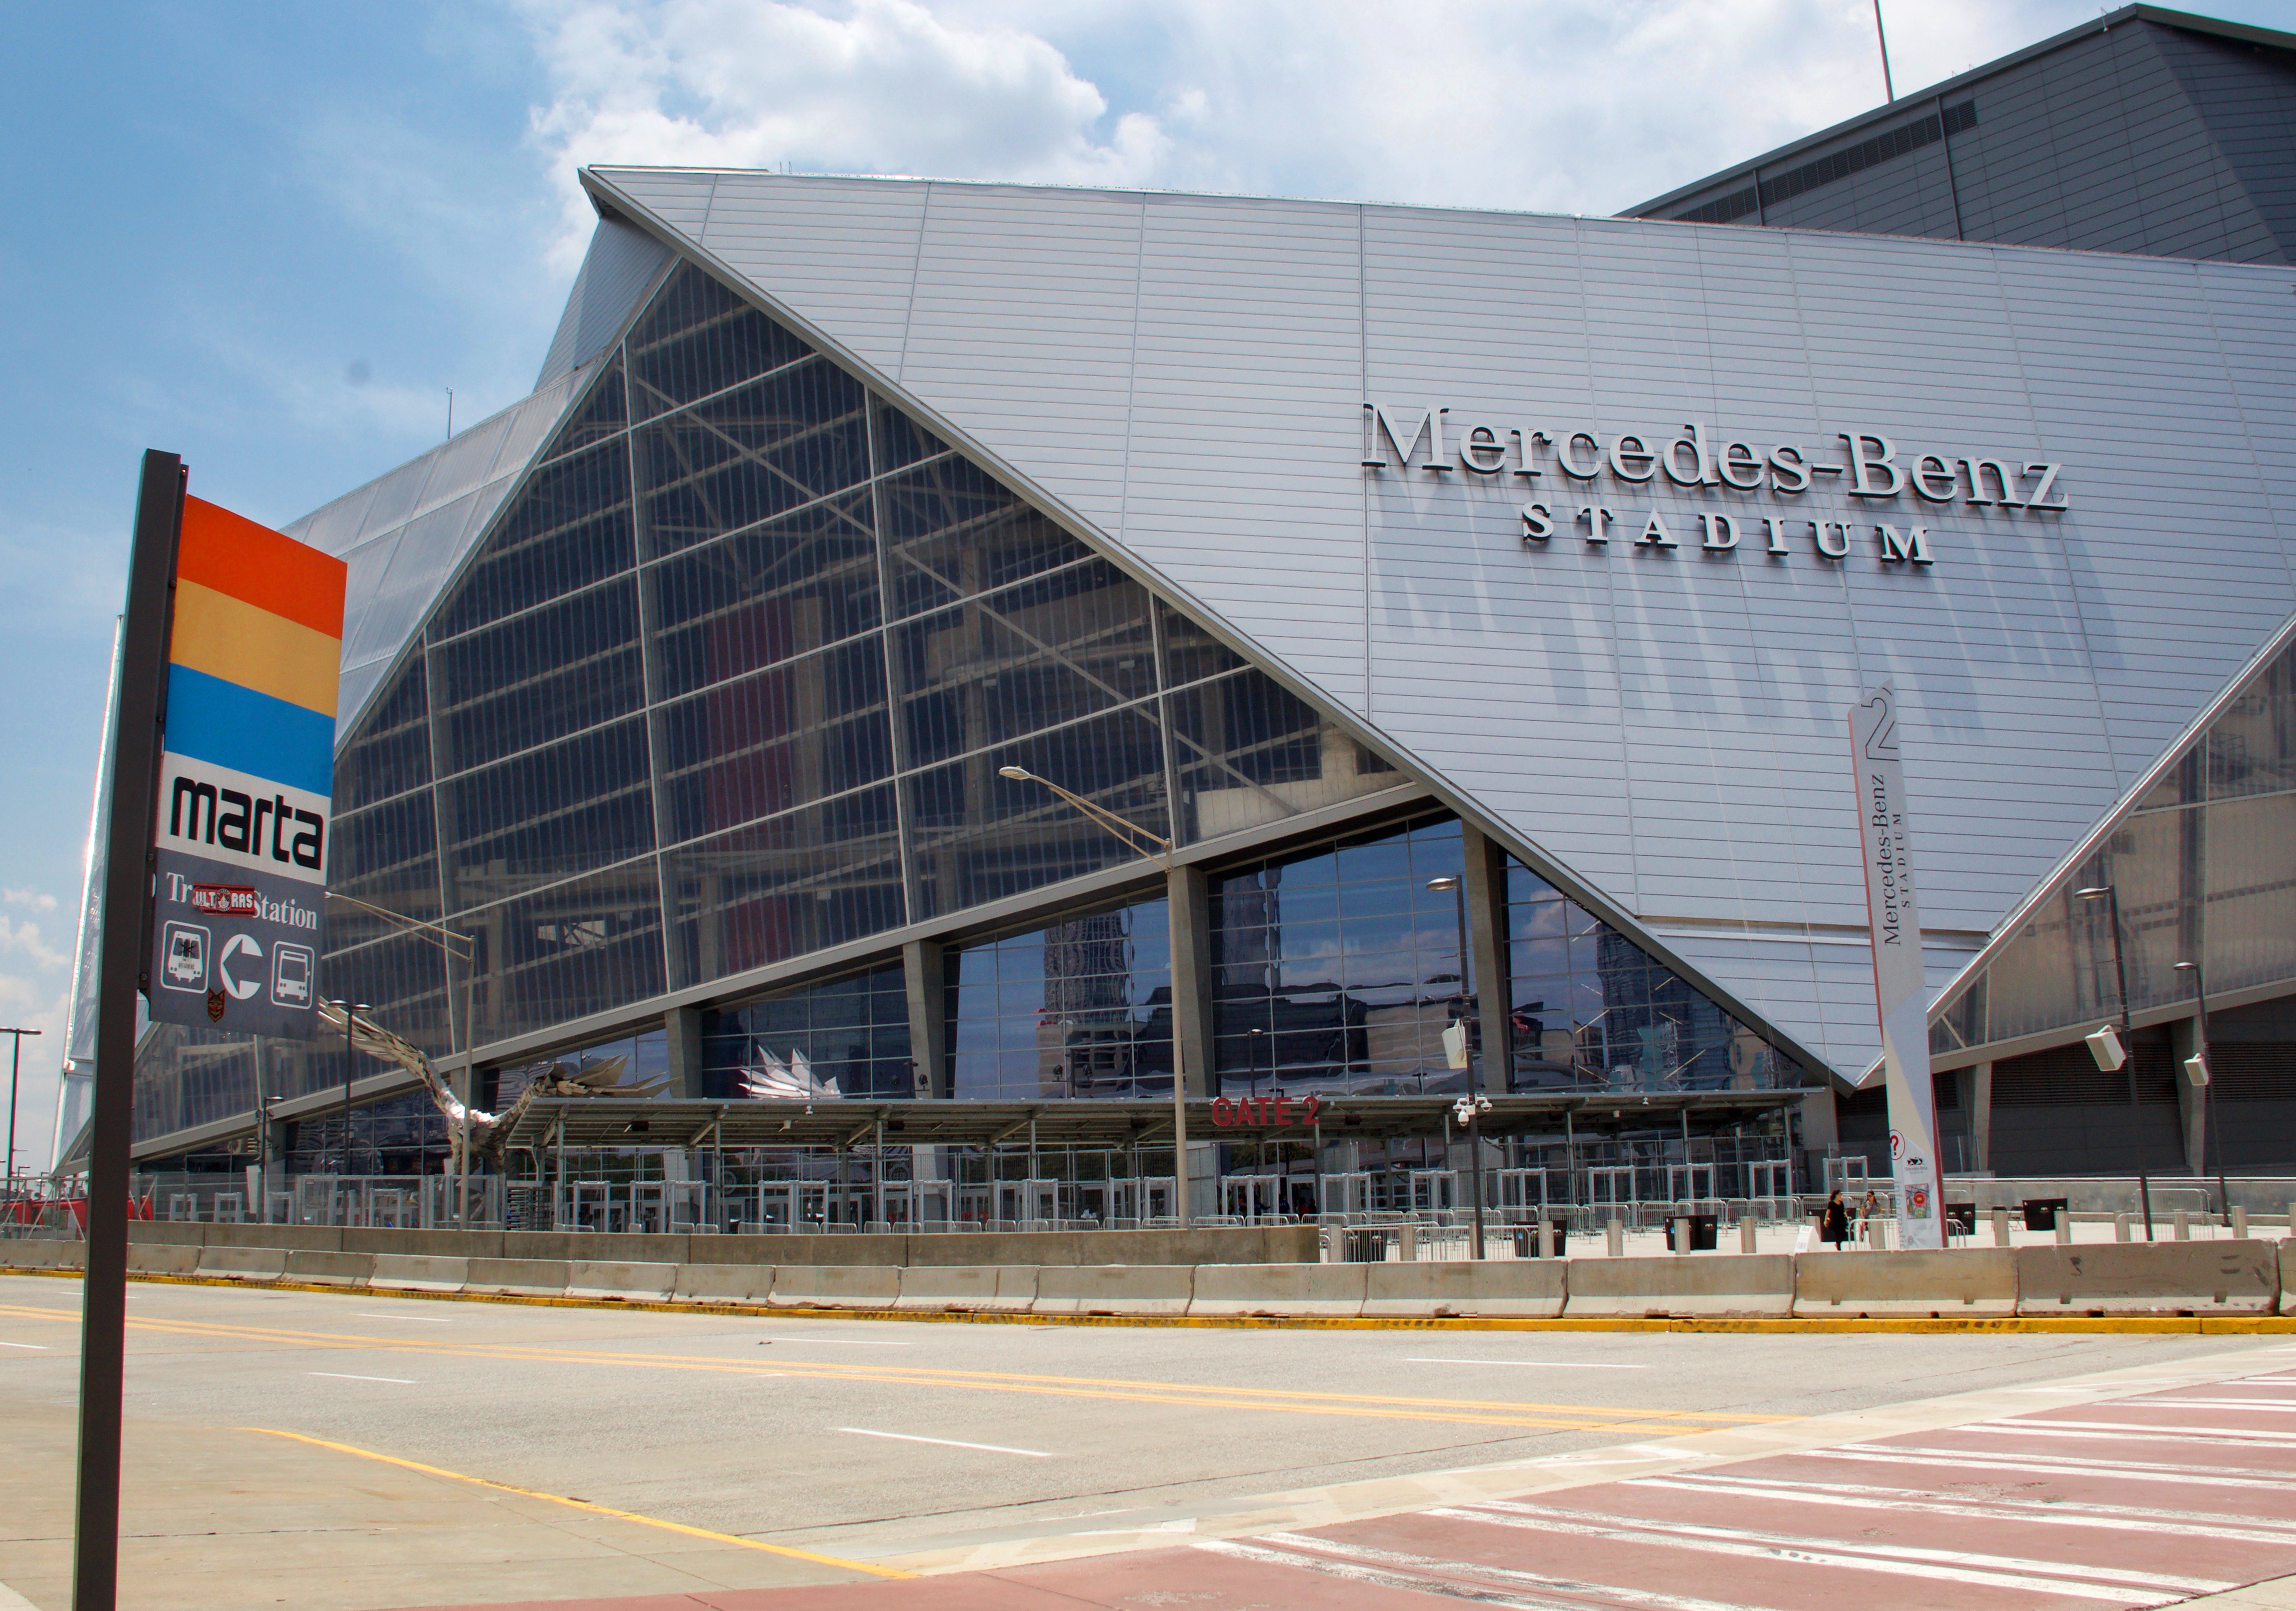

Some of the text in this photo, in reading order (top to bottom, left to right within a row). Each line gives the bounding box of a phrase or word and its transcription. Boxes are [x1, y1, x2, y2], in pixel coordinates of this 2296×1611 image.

[1362, 401, 2068, 512] Mercedes-Benz
[1522, 501, 1934, 565] STADIUM
[1861, 687, 1900, 761] 2
[170, 776, 324, 871] marta
[1872, 774, 1901, 946] Mercedes-Benz
[1891, 812, 1910, 908] STADIUM
[252, 890, 317, 930] Station
[1212, 1095, 1319, 1126] GATE 2
